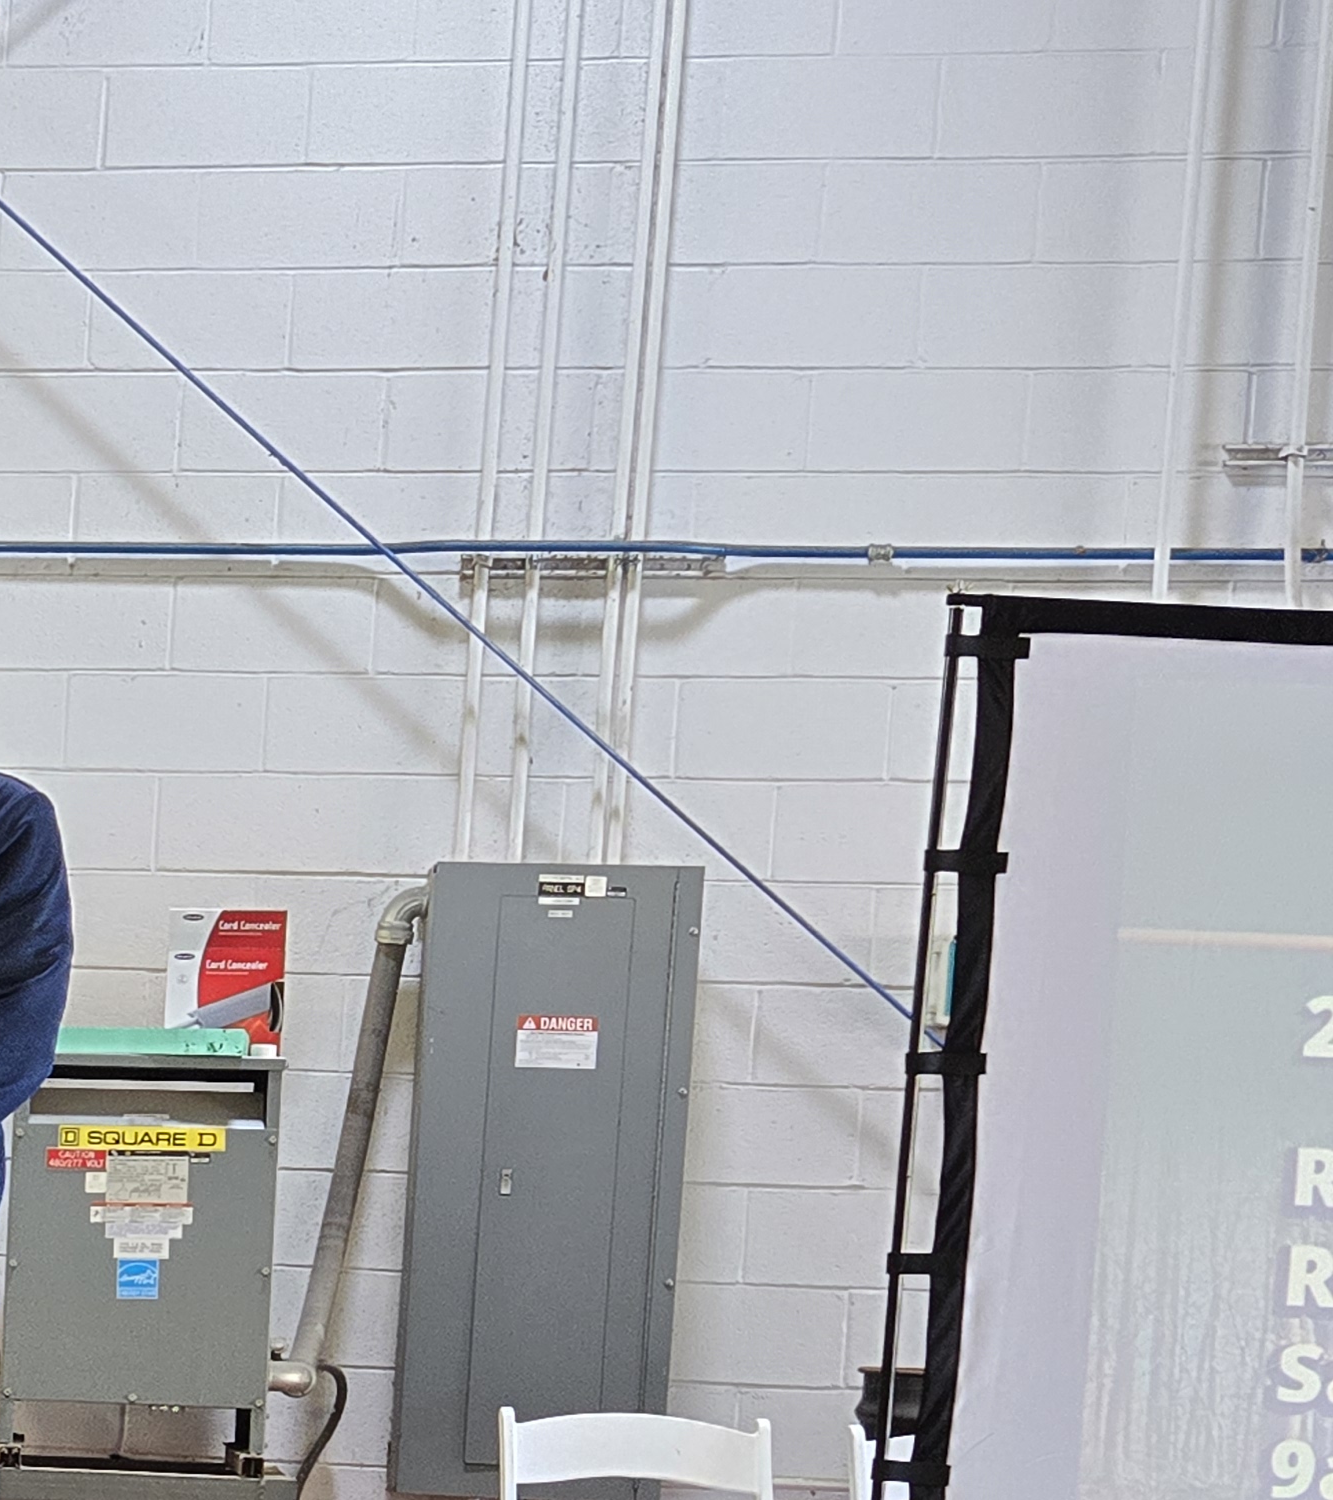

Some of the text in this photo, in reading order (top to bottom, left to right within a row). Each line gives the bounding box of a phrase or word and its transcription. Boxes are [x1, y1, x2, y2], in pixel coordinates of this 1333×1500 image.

[218, 920, 282, 931] Cord Concealer
[205, 959, 269, 970] Cord Concealer
[540, 1017, 593, 1031] DANGER
[87, 1131, 187, 1147] SQUARE
[197, 1132, 217, 1147] D
[1294, 1148, 1333, 1208] R
[1286, 1244, 1333, 1308] R
[1277, 1343, 1333, 1404] S
